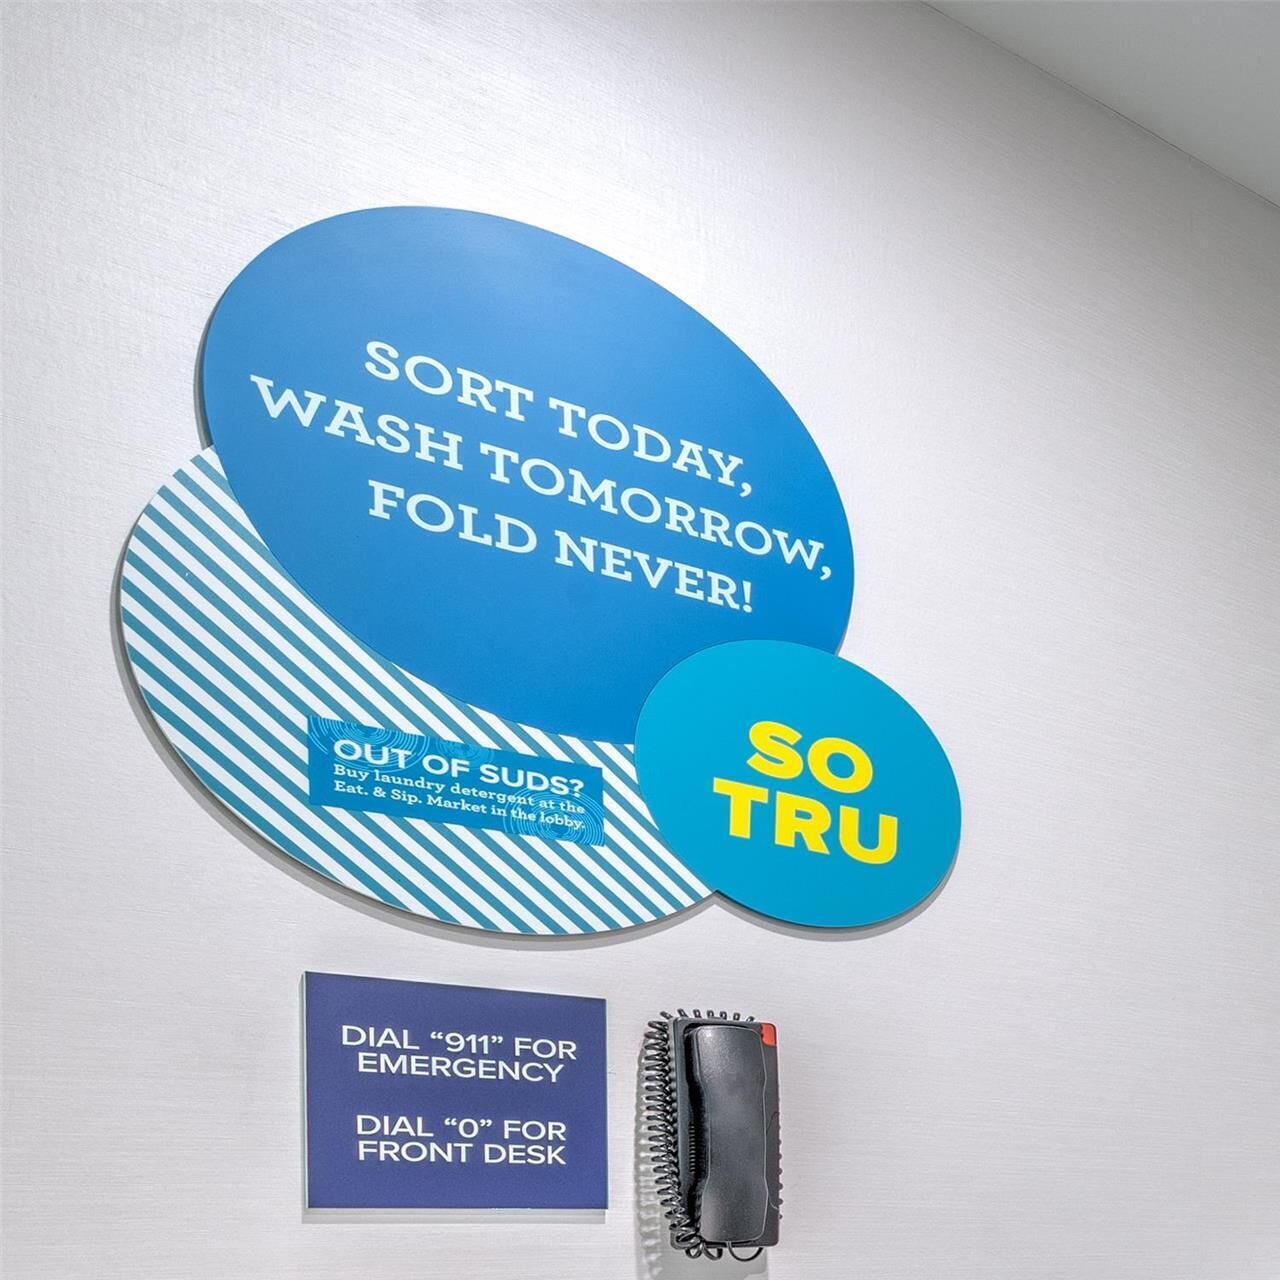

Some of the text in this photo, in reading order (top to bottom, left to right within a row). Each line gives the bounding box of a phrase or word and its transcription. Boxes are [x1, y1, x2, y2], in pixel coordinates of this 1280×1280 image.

[364, 341, 753, 497] SORT TODAY,
[250, 374, 832, 581] WASH TOMORROW,
[368, 479, 753, 614] FOLD NEVER!
[334, 739, 584, 797] OUT OF SUDS?
[746, 720, 873, 794] SO
[333, 764, 585, 814] Buy laundry detergent at the
[334, 780, 586, 831] Eat. & Sip. Market in the lobby.
[713, 777, 898, 864] TRU
[341, 1025, 419, 1050] DIAL
[515, 1038, 577, 1060] FOR
[357, 1052, 564, 1083] EMERGENCY
[356, 1114, 433, 1136] DIAL
[504, 1120, 567, 1140] FOR
[358, 1141, 566, 1165] FRONT DESK
